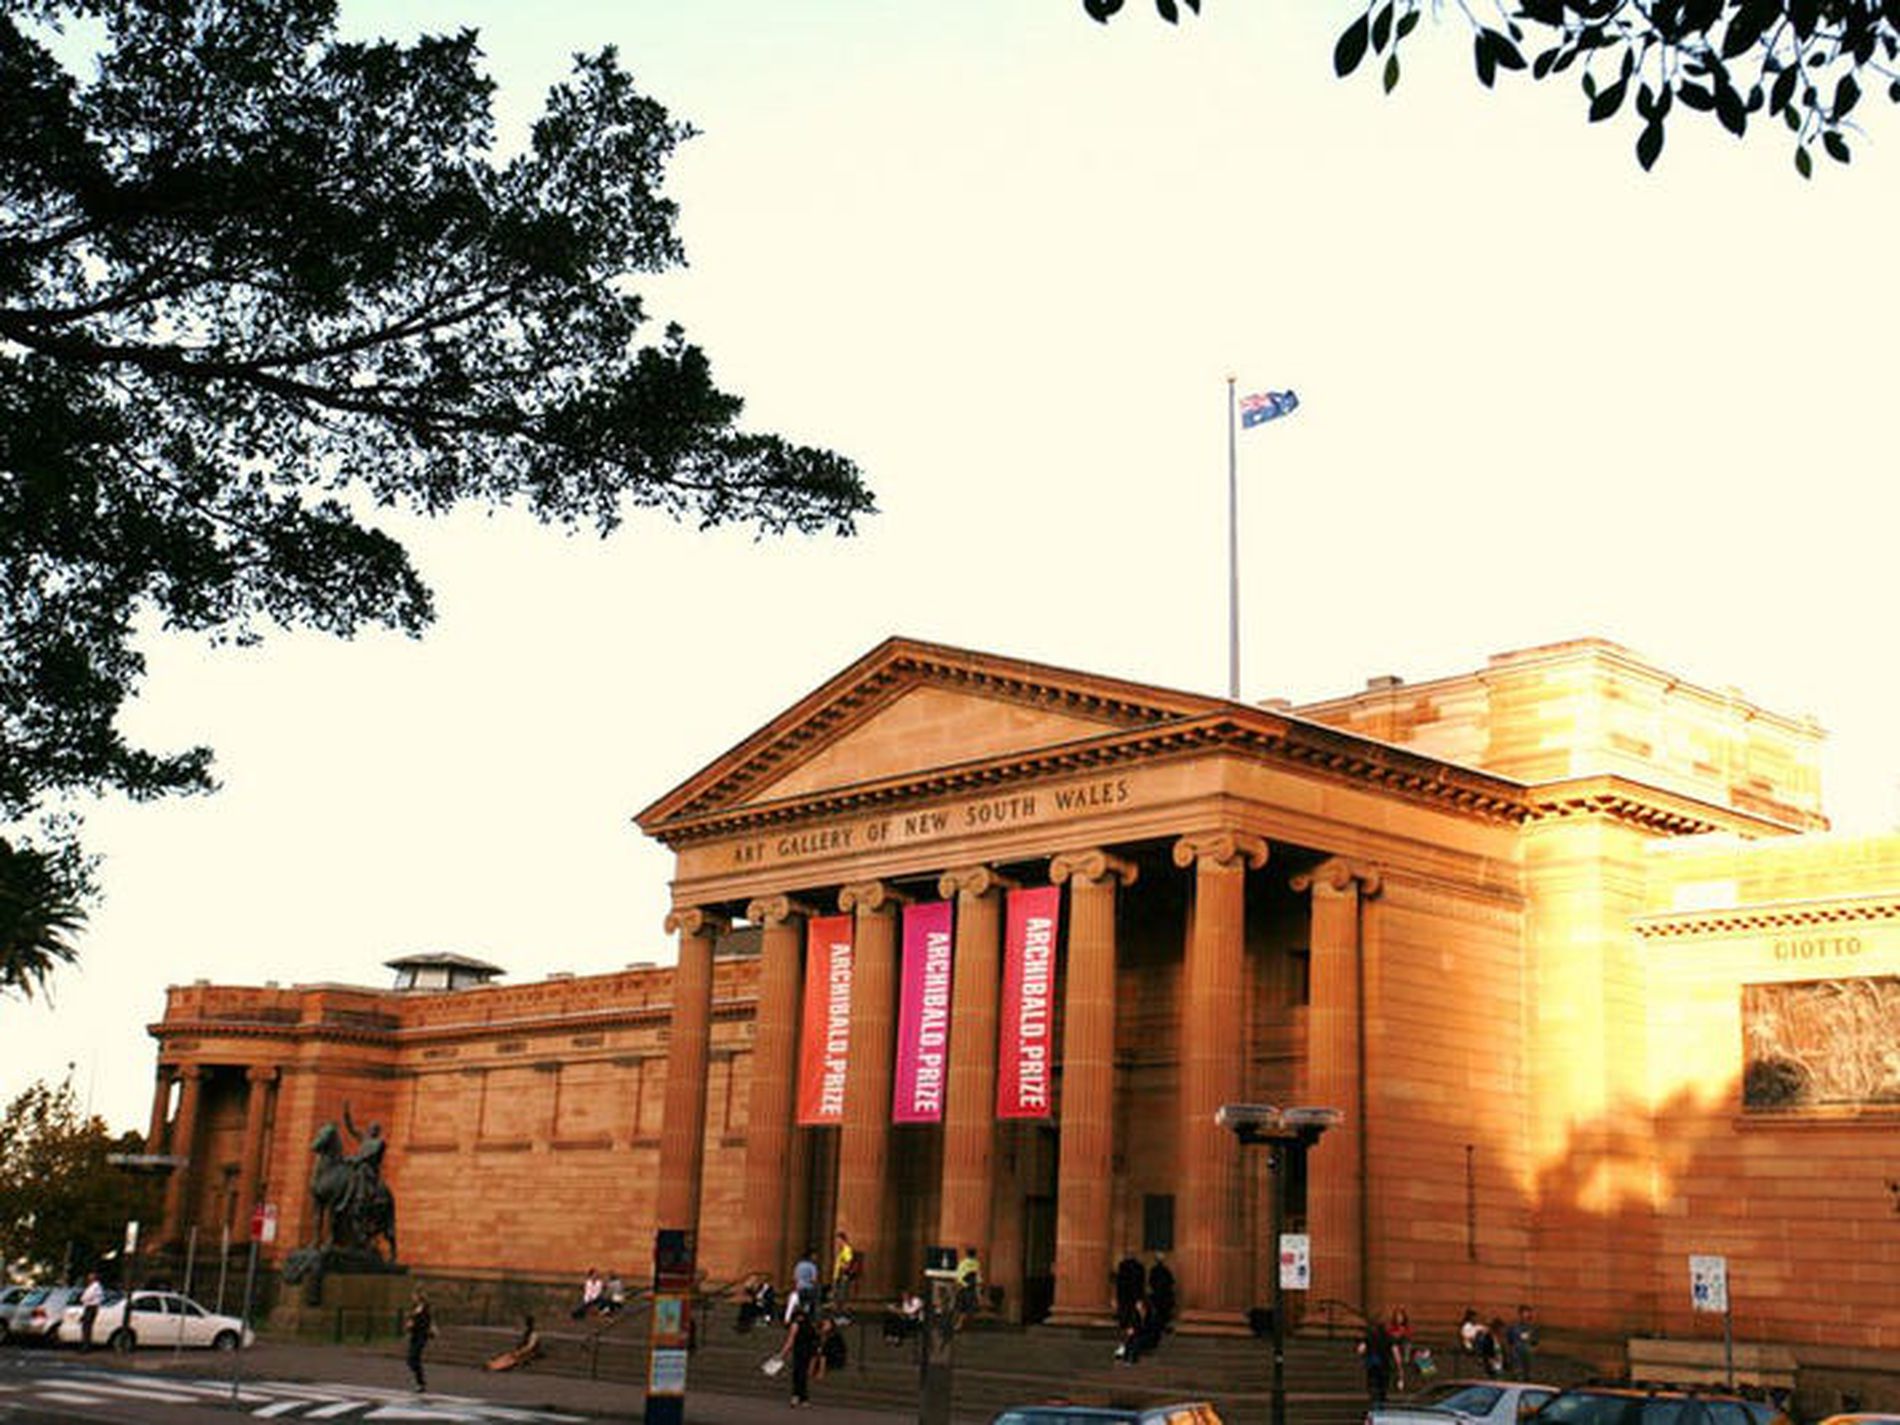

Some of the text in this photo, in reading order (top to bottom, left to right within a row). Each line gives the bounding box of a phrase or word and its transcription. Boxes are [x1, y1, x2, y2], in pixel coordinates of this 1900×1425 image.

[734, 780, 1129, 862] ART GALLERY OF NEW SOUTH WALES
[1774, 937, 1861, 960] GIOTTO
